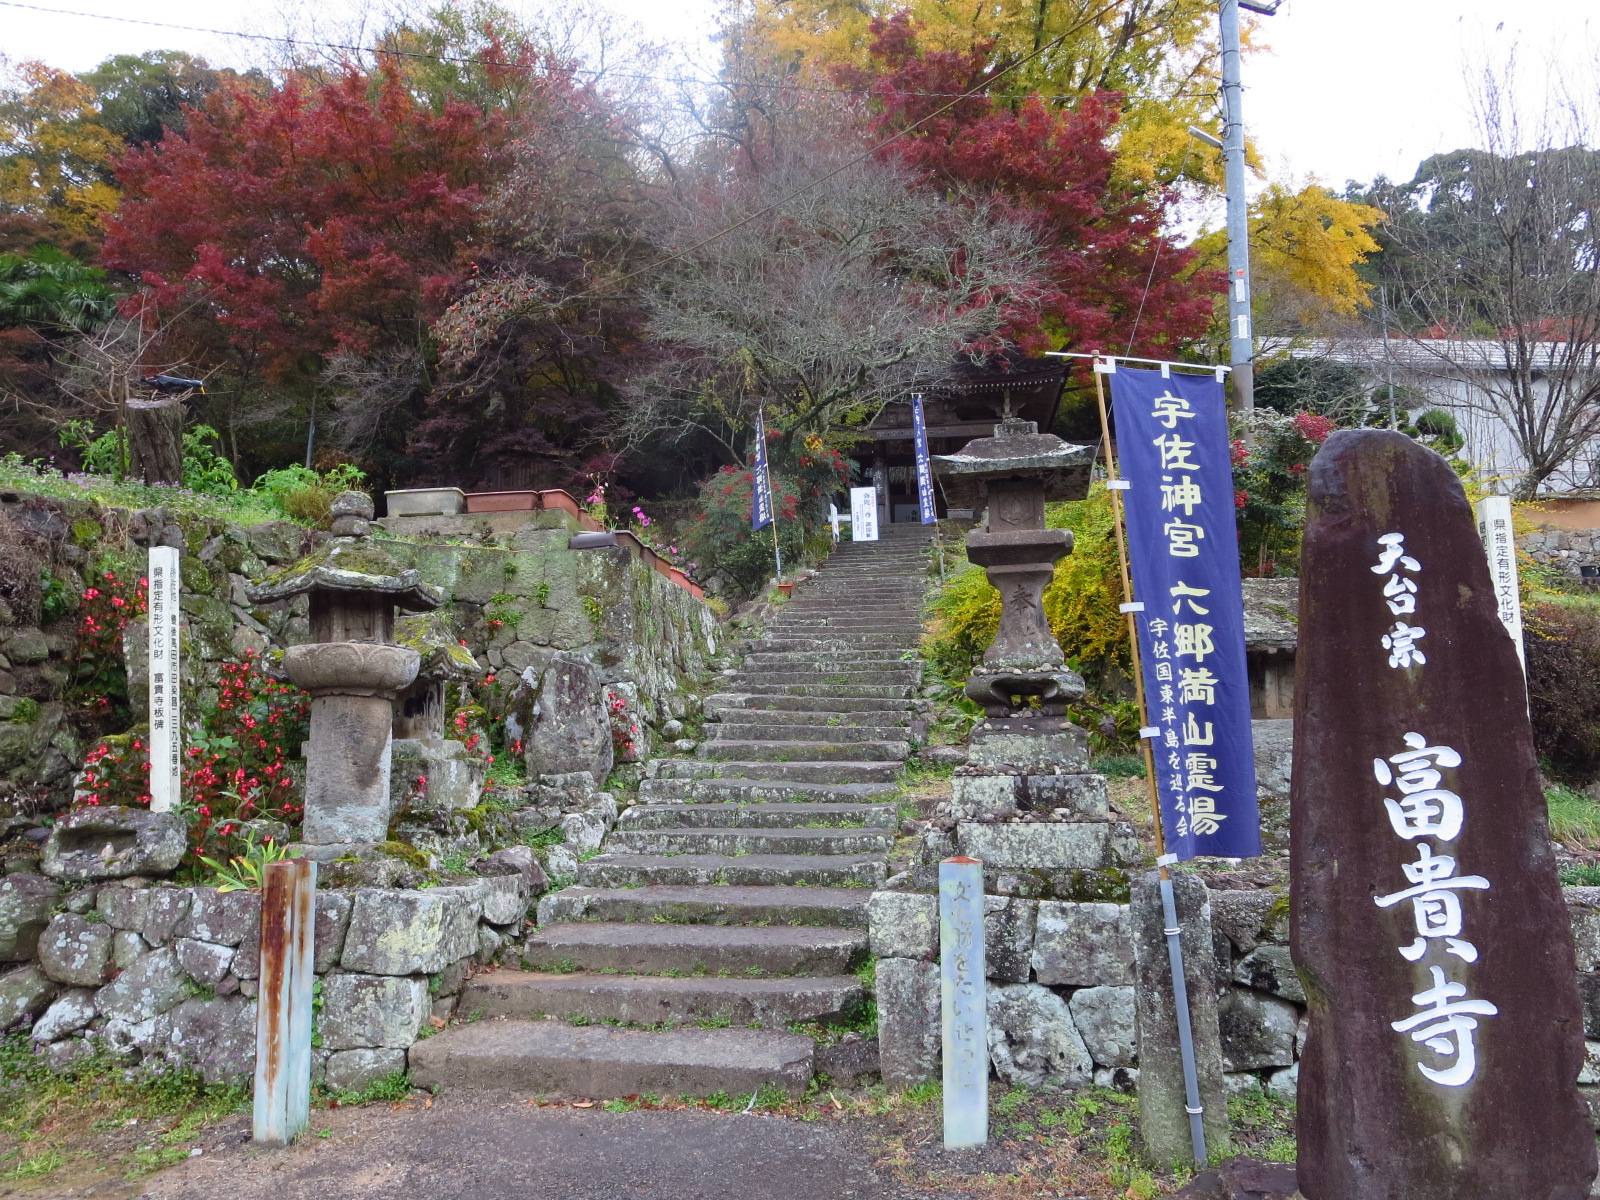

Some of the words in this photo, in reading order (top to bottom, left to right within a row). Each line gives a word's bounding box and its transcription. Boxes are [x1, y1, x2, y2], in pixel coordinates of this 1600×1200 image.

[1151, 390, 1205, 558] 宇佐神宮
[153, 566, 164, 660] 県指定有形文化財
[1371, 532, 1426, 669] 天台宗
[1493, 518, 1514, 624] 県指定有形文化財
[153, 673, 164, 730] 富貴寺板碑
[1149, 618, 1189, 838] 宇佐国東半島を巡る会
[1170, 580, 1228, 836] 六郷満山霊場
[1373, 732, 1499, 1086] 富貴寺
